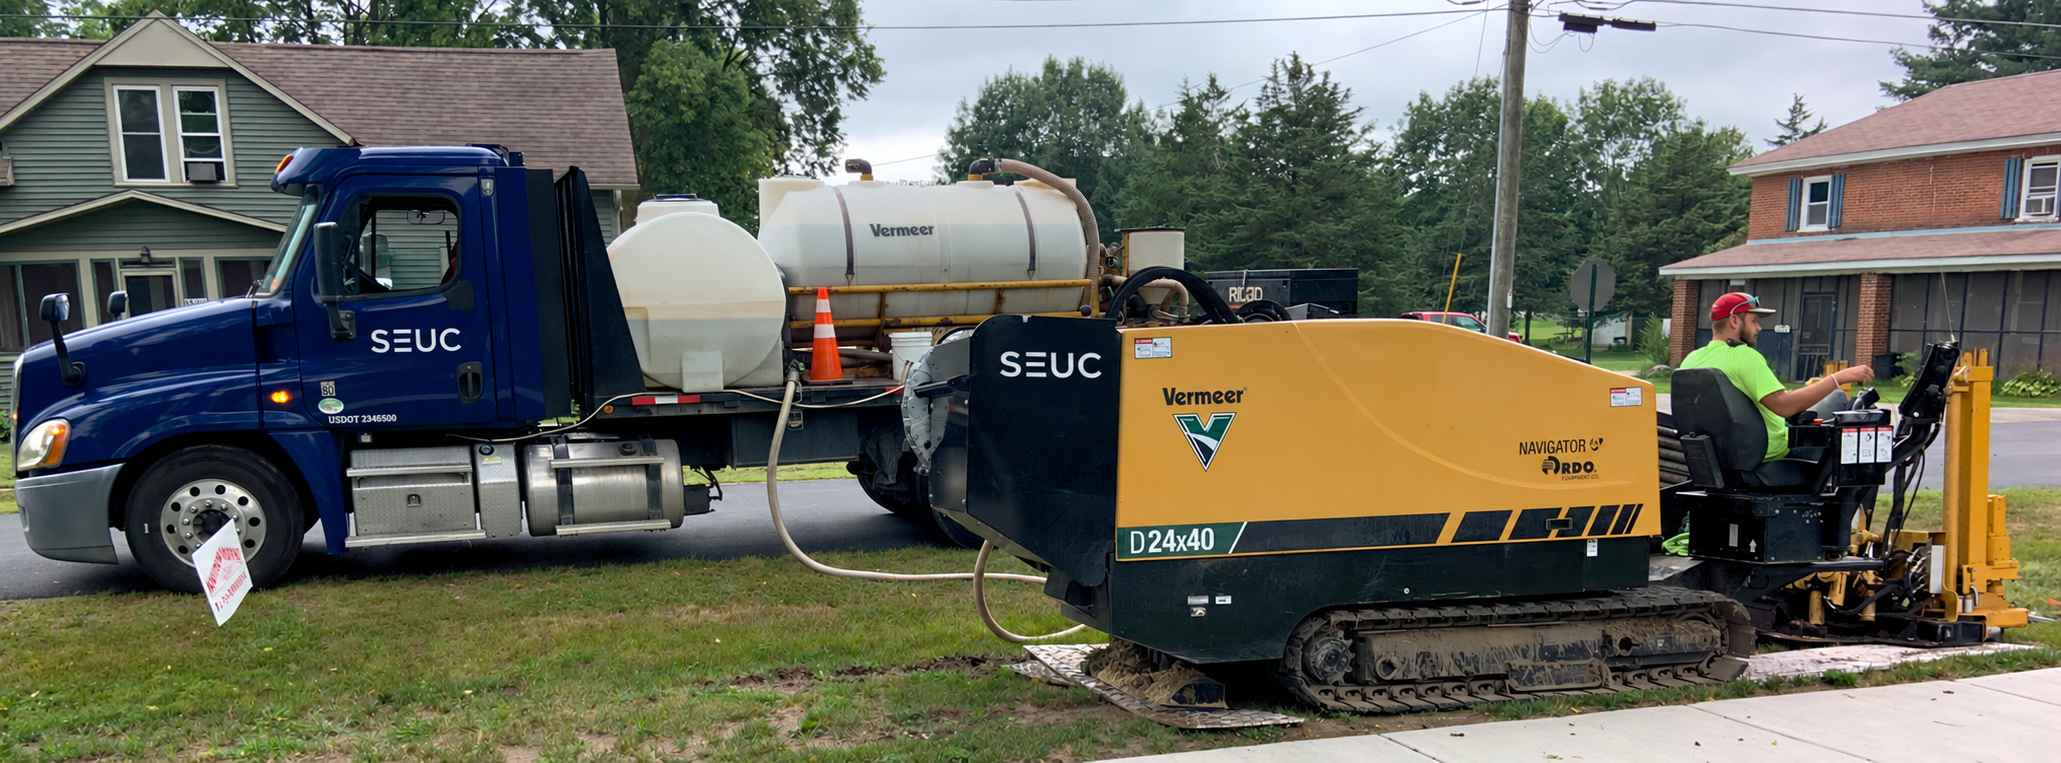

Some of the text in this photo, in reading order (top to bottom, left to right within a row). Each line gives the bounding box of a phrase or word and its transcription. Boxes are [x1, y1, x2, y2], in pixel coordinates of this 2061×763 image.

[869, 223, 934, 237] Vermeer
[370, 327, 462, 353] SEUC
[999, 350, 1102, 379] SEUC
[1162, 387, 1244, 406] Vermeer
[328, 415, 359, 424] USDOT
[1519, 439, 1586, 455] NAVIGATOR
